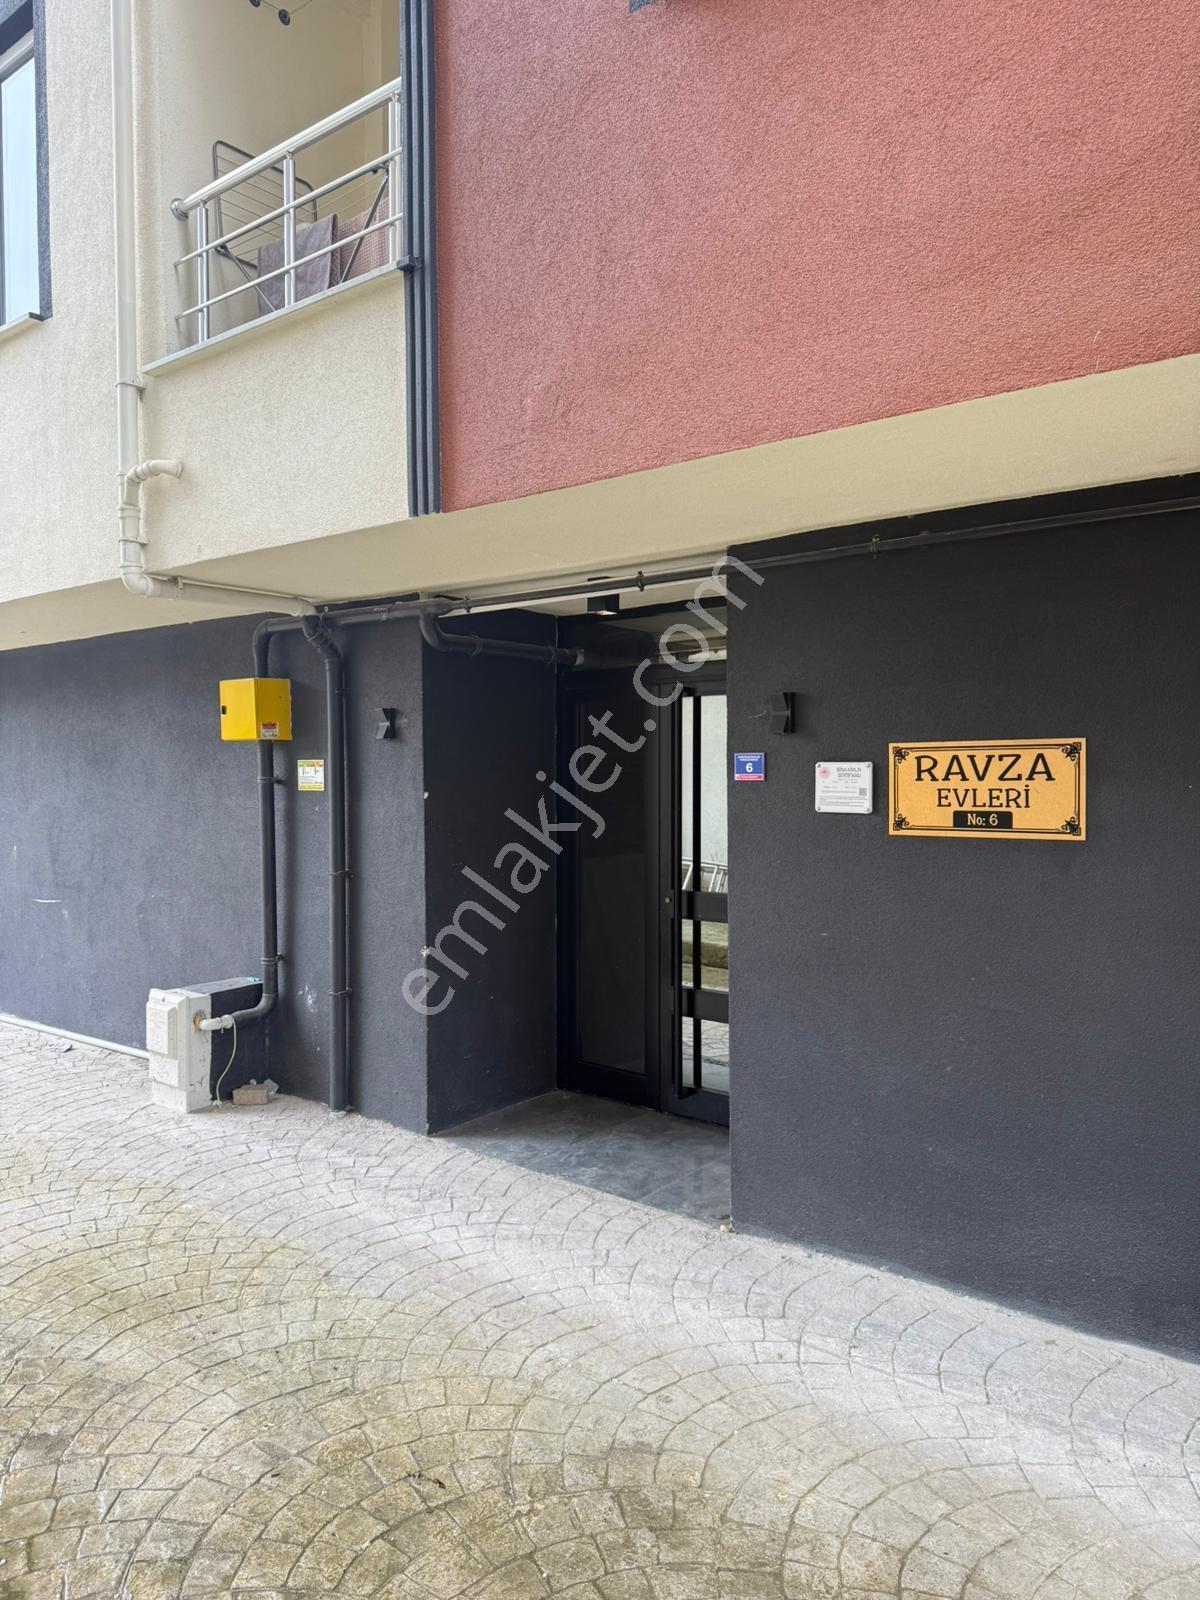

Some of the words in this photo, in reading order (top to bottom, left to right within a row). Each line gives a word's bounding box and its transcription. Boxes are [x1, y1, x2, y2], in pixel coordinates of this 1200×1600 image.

[745, 762, 753, 773] 6
[914, 753, 1056, 782] RAVZA
[936, 784, 1031, 808] EVLERİ
[967, 813, 986, 826] No:
[989, 813, 998, 826] 6
